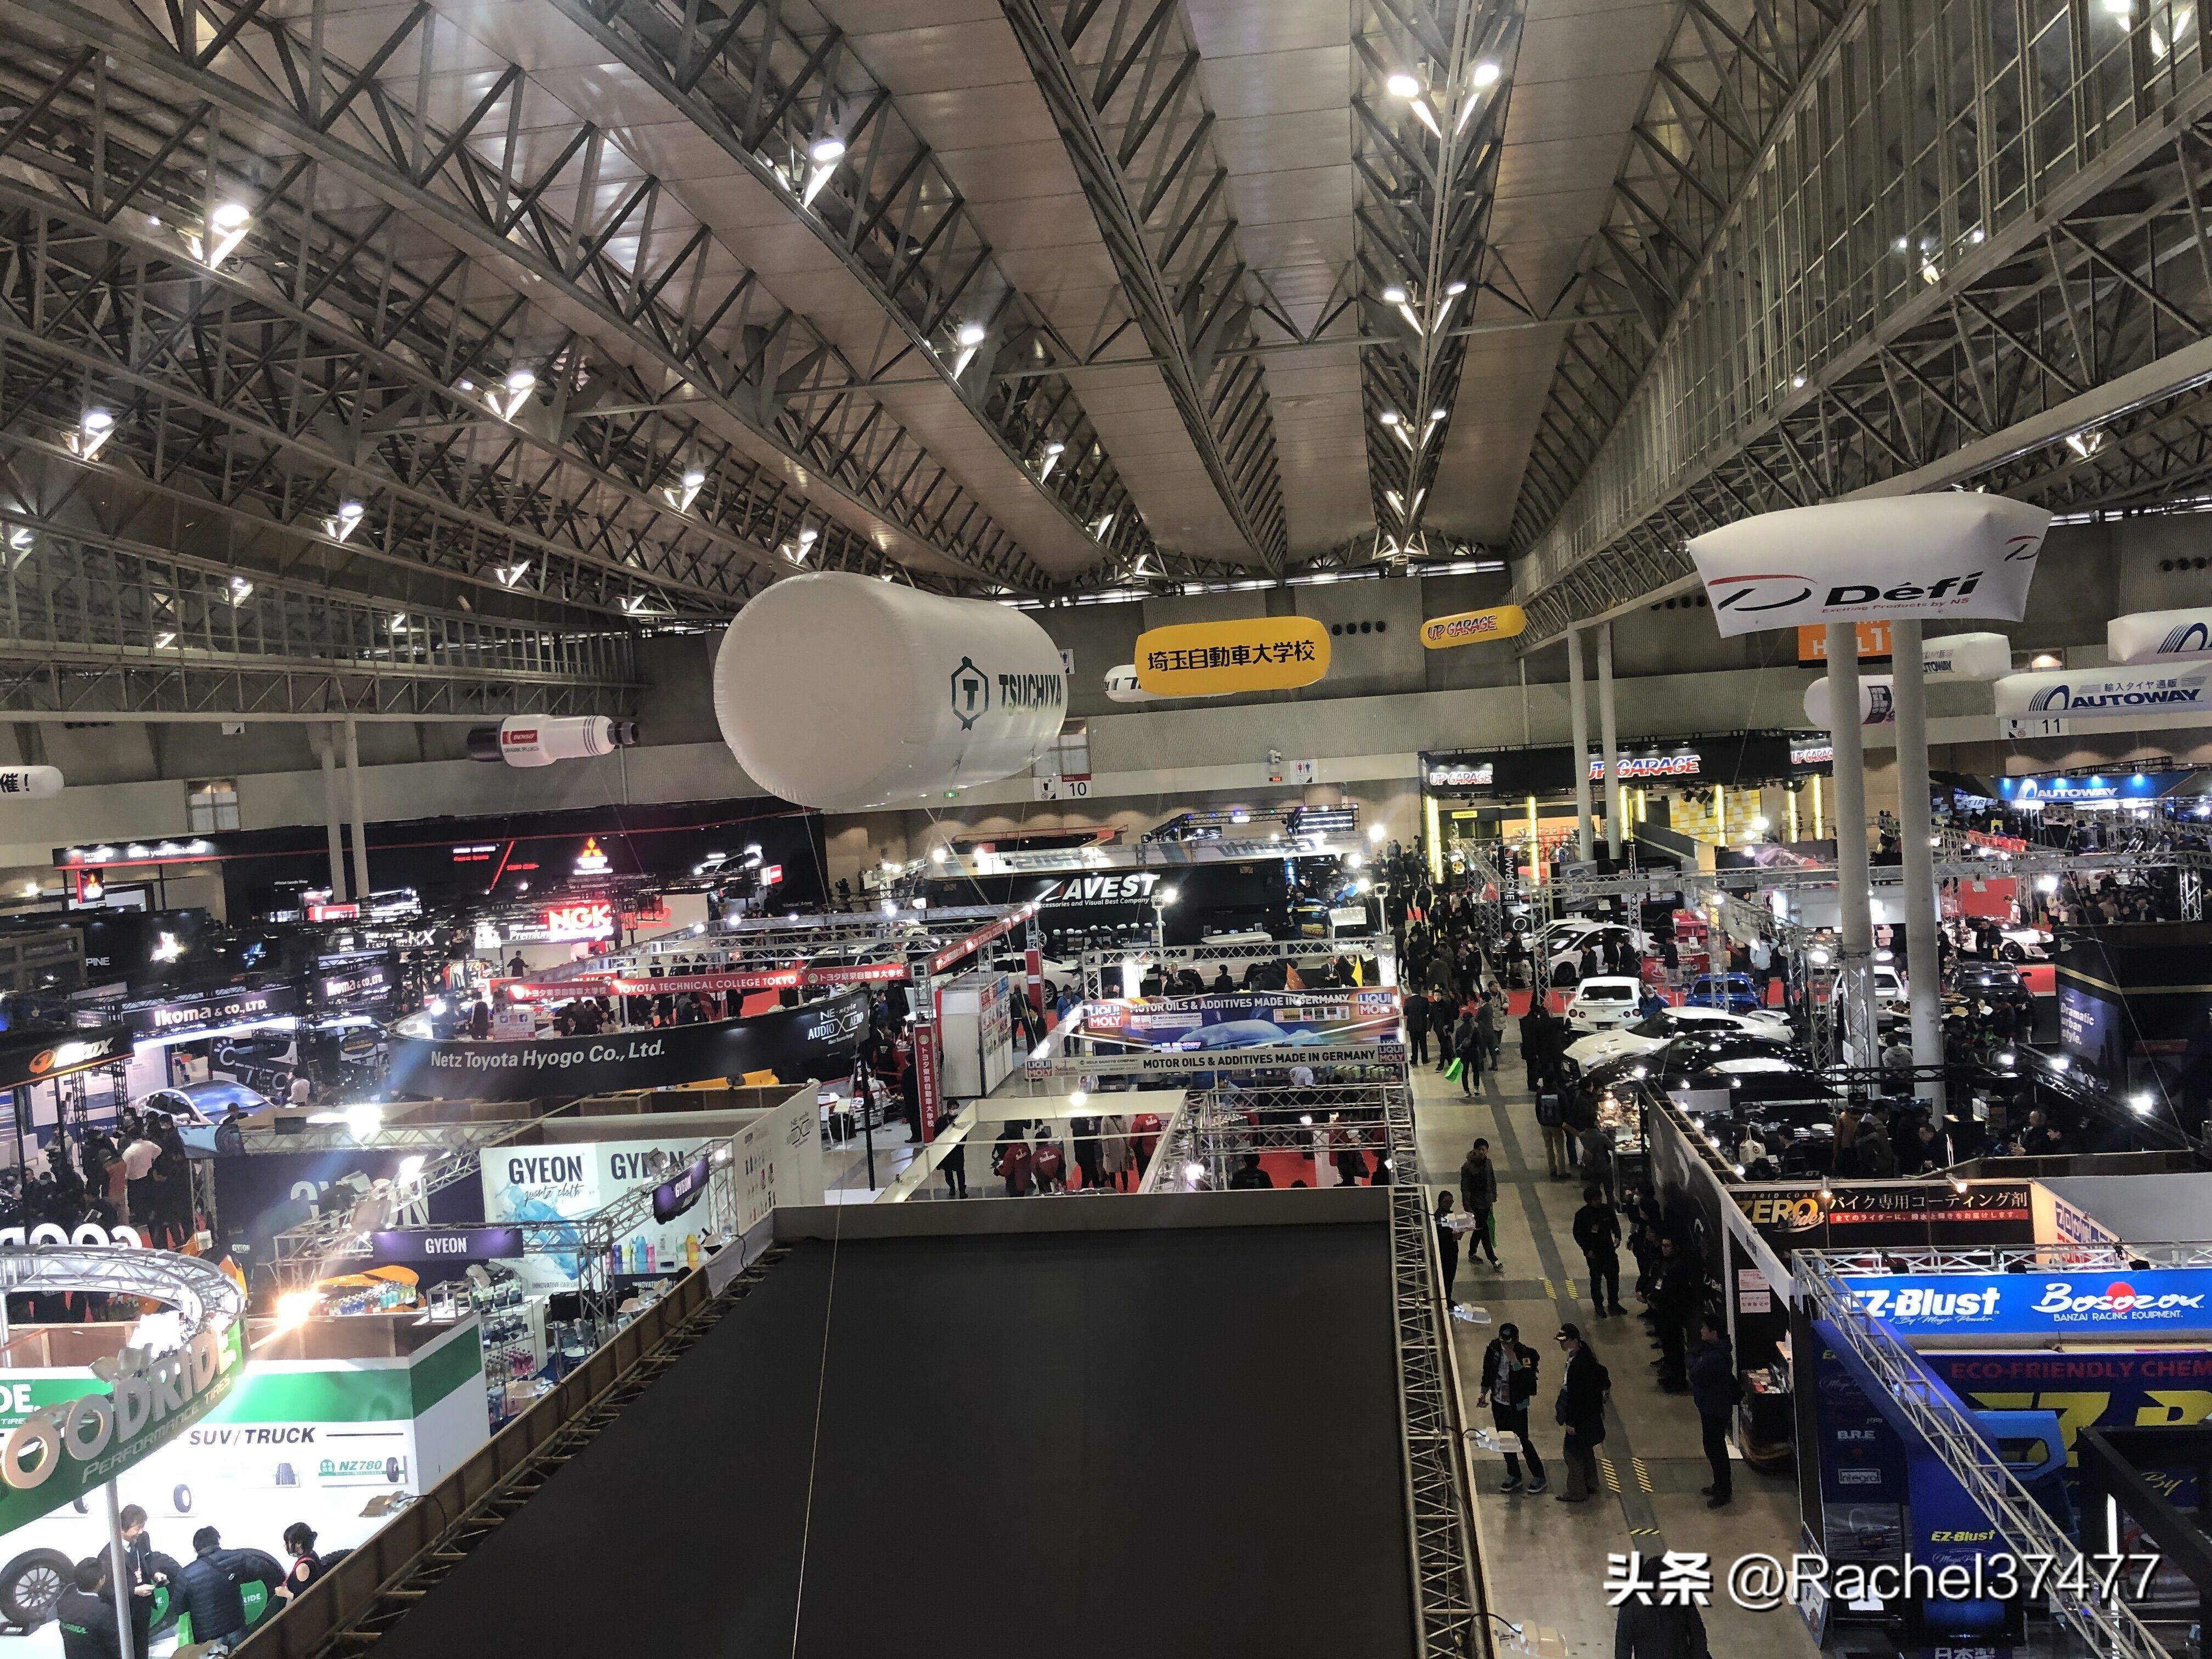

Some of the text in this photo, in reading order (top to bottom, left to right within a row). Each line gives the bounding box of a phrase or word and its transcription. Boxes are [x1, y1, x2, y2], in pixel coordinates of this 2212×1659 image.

[1872, 602, 1929, 610] Products
[1427, 615, 1498, 640] UP GARAGE
[1148, 639, 1316, 673] 埼玉自動車大学校
[1923, 660, 1953, 673] UTOWAY
[997, 674, 1062, 712] TSUCHIYA
[2071, 689, 2202, 708] AUTOWAY
[2041, 718, 2061, 734] 11
[512, 733, 536, 741] DENSO
[1804, 747, 1833, 763] GARAG
[1616, 755, 1701, 779] GARAGE
[1430, 770, 1493, 786] UP GARAGE
[1069, 782, 1087, 797] 10
[2037, 787, 2119, 798] AUTOWAY
[549, 904, 612, 931] NGK
[618, 975, 797, 994] TOYOTA TECHNICAL COLLEGE TOKYO
[1130, 1002, 1164, 1013] MOTOR
[1166, 1001, 1188, 1012] OILS
[1190, 1001, 1198, 1009] &
[1200, 997, 1253, 1010] ADDITIVES
[1254, 996, 1284, 1008] MADE
[1299, 993, 1350, 1005] GERMANY
[1358, 993, 1392, 1004] LIQUI
[154, 1006, 211, 1028] Ikoma
[214, 1008, 222, 1017] &
[1088, 1005, 1121, 1016] LIQUI
[2060, 1002, 2095, 1026] Dramatic
[807, 1012, 864, 1041] AUDIO AERO
[1090, 1016, 1121, 1027] MOLY
[2061, 1016, 2083, 1033] urban
[2061, 1028, 2082, 1045] style.
[430, 1039, 665, 1071] Netz Toyota Hyogo Co., Ltd.
[1378, 1045, 1403, 1054] LIQUI
[1379, 1054, 1404, 1062] MOLY
[1026, 1060, 1052, 1069] LIQUI
[1143, 1058, 1180, 1069] MOTOR
[1181, 1057, 1205, 1068] OILS
[1207, 1057, 1216, 1066] &
[1217, 1053, 1273, 1066] ADDITIVES
[1276, 1052, 1307, 1063] MADE
[1308, 1051, 1319, 1062] IN
[1322, 1050, 1375, 1062] GERMANY
[1027, 1069, 1052, 1077] MOLY
[508, 1155, 583, 1184] GYEON
[675, 1175, 691, 1198] GYEON
[1829, 1191, 2027, 1210] バイク専用コーティング剤
[1735, 1198, 1819, 1224] ZERO
[425, 1237, 466, 1254] GYEON
[2053, 1310, 2184, 1322] BANZAI RACING EQUIPMENT.
[1951, 1362, 2134, 1379] ECO-FRIENDLY
[82, 1373, 230, 1483] PERFORMANCE TIRES
[338, 1460, 382, 1471] NZ780
[1931, 1529, 1996, 1543] EZ-Blust
